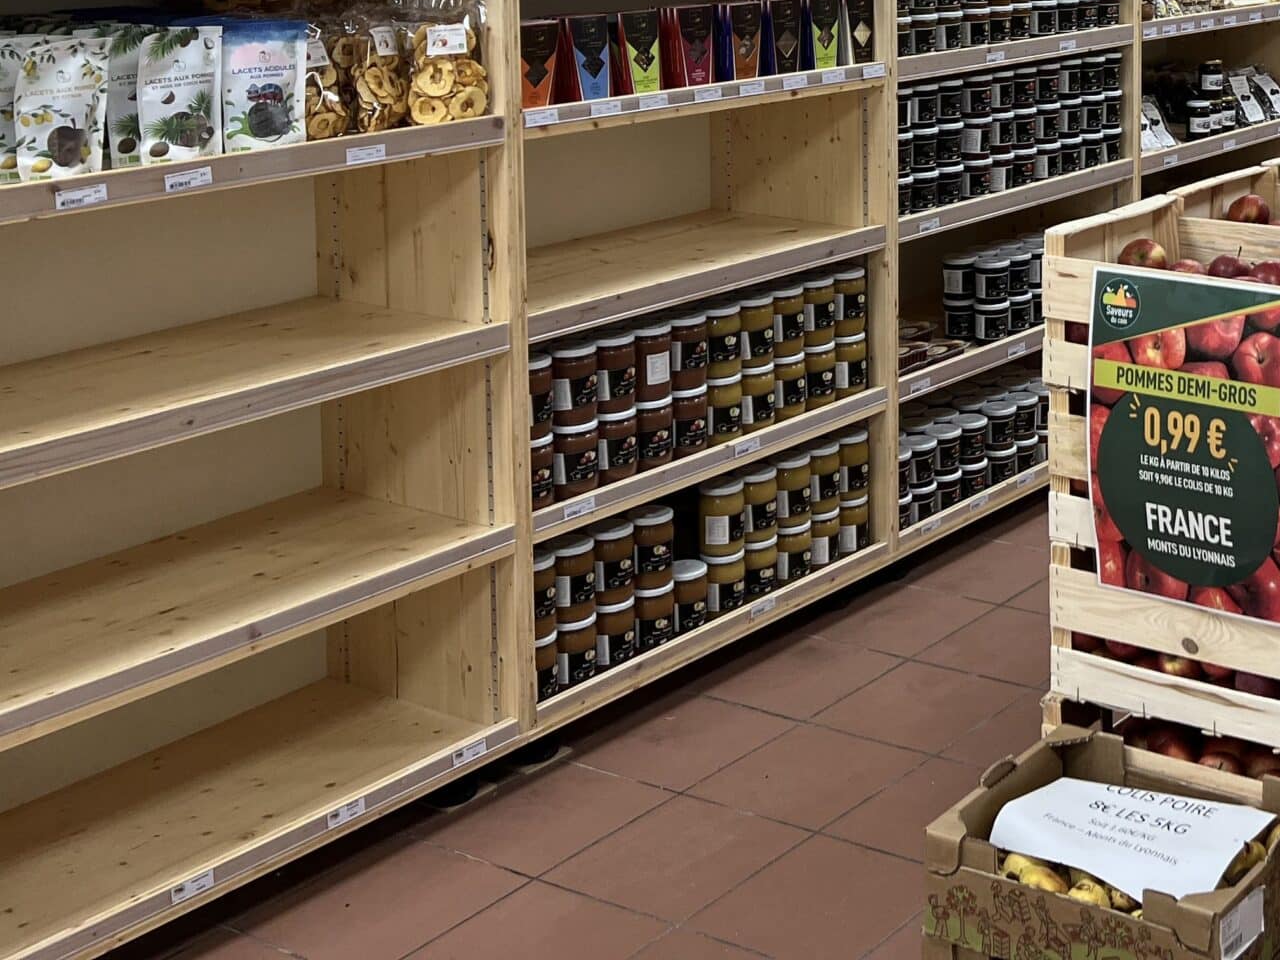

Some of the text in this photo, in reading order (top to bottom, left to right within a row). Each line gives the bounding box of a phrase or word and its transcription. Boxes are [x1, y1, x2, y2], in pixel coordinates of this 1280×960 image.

[1106, 305, 1133, 318] Saveurs
[1116, 366, 1257, 407] POMMES DEMI-GROS
[1144, 406, 1226, 459] 0,99 €
[1140, 454, 1148, 465] LE
[1149, 456, 1159, 467] KG
[1166, 459, 1190, 474] PARTIR
[1191, 464, 1200, 476] DE
[1201, 466, 1209, 477] 10
[1210, 468, 1231, 481] KILOS
[1138, 470, 1154, 482] SOIT
[1174, 476, 1182, 488] LE
[1183, 478, 1204, 492] COLIS
[1204, 482, 1214, 494] DE
[1214, 484, 1222, 495] 10
[1223, 486, 1234, 498] KG
[1145, 501, 1234, 547] FRANCE
[1147, 537, 1236, 568] MONTS DU LYONNAIS
[1115, 807, 1150, 823] LES
[1149, 816, 1192, 836] 5KG
[1159, 796, 1218, 819] POIRE
